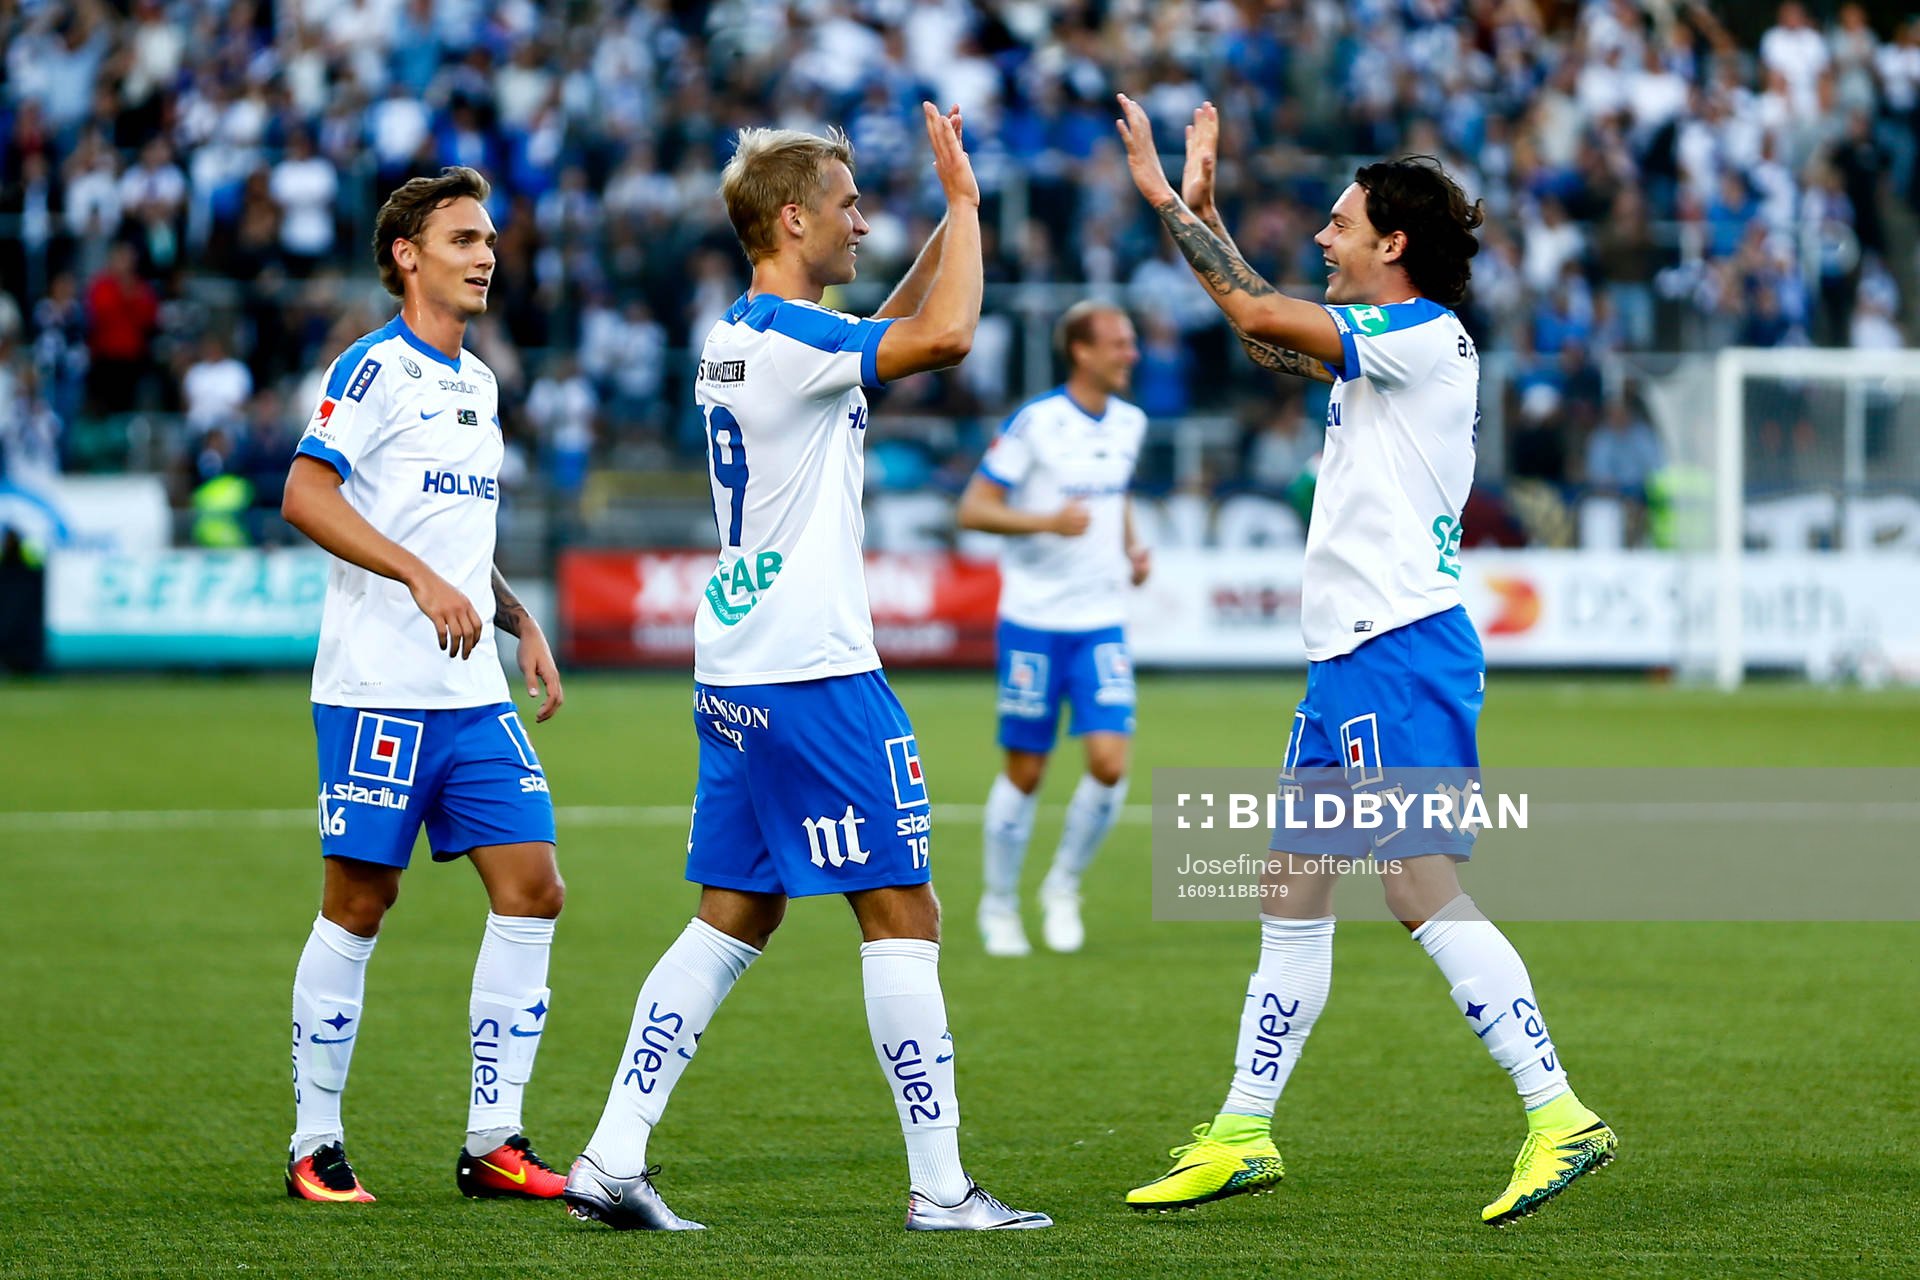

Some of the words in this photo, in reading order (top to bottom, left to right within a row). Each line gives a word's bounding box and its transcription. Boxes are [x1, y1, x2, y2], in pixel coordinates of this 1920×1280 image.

[422, 470, 497, 501] HOLME
[702, 405, 749, 547] 9
[802, 805, 870, 888] nt
[907, 835, 929, 869] 19
